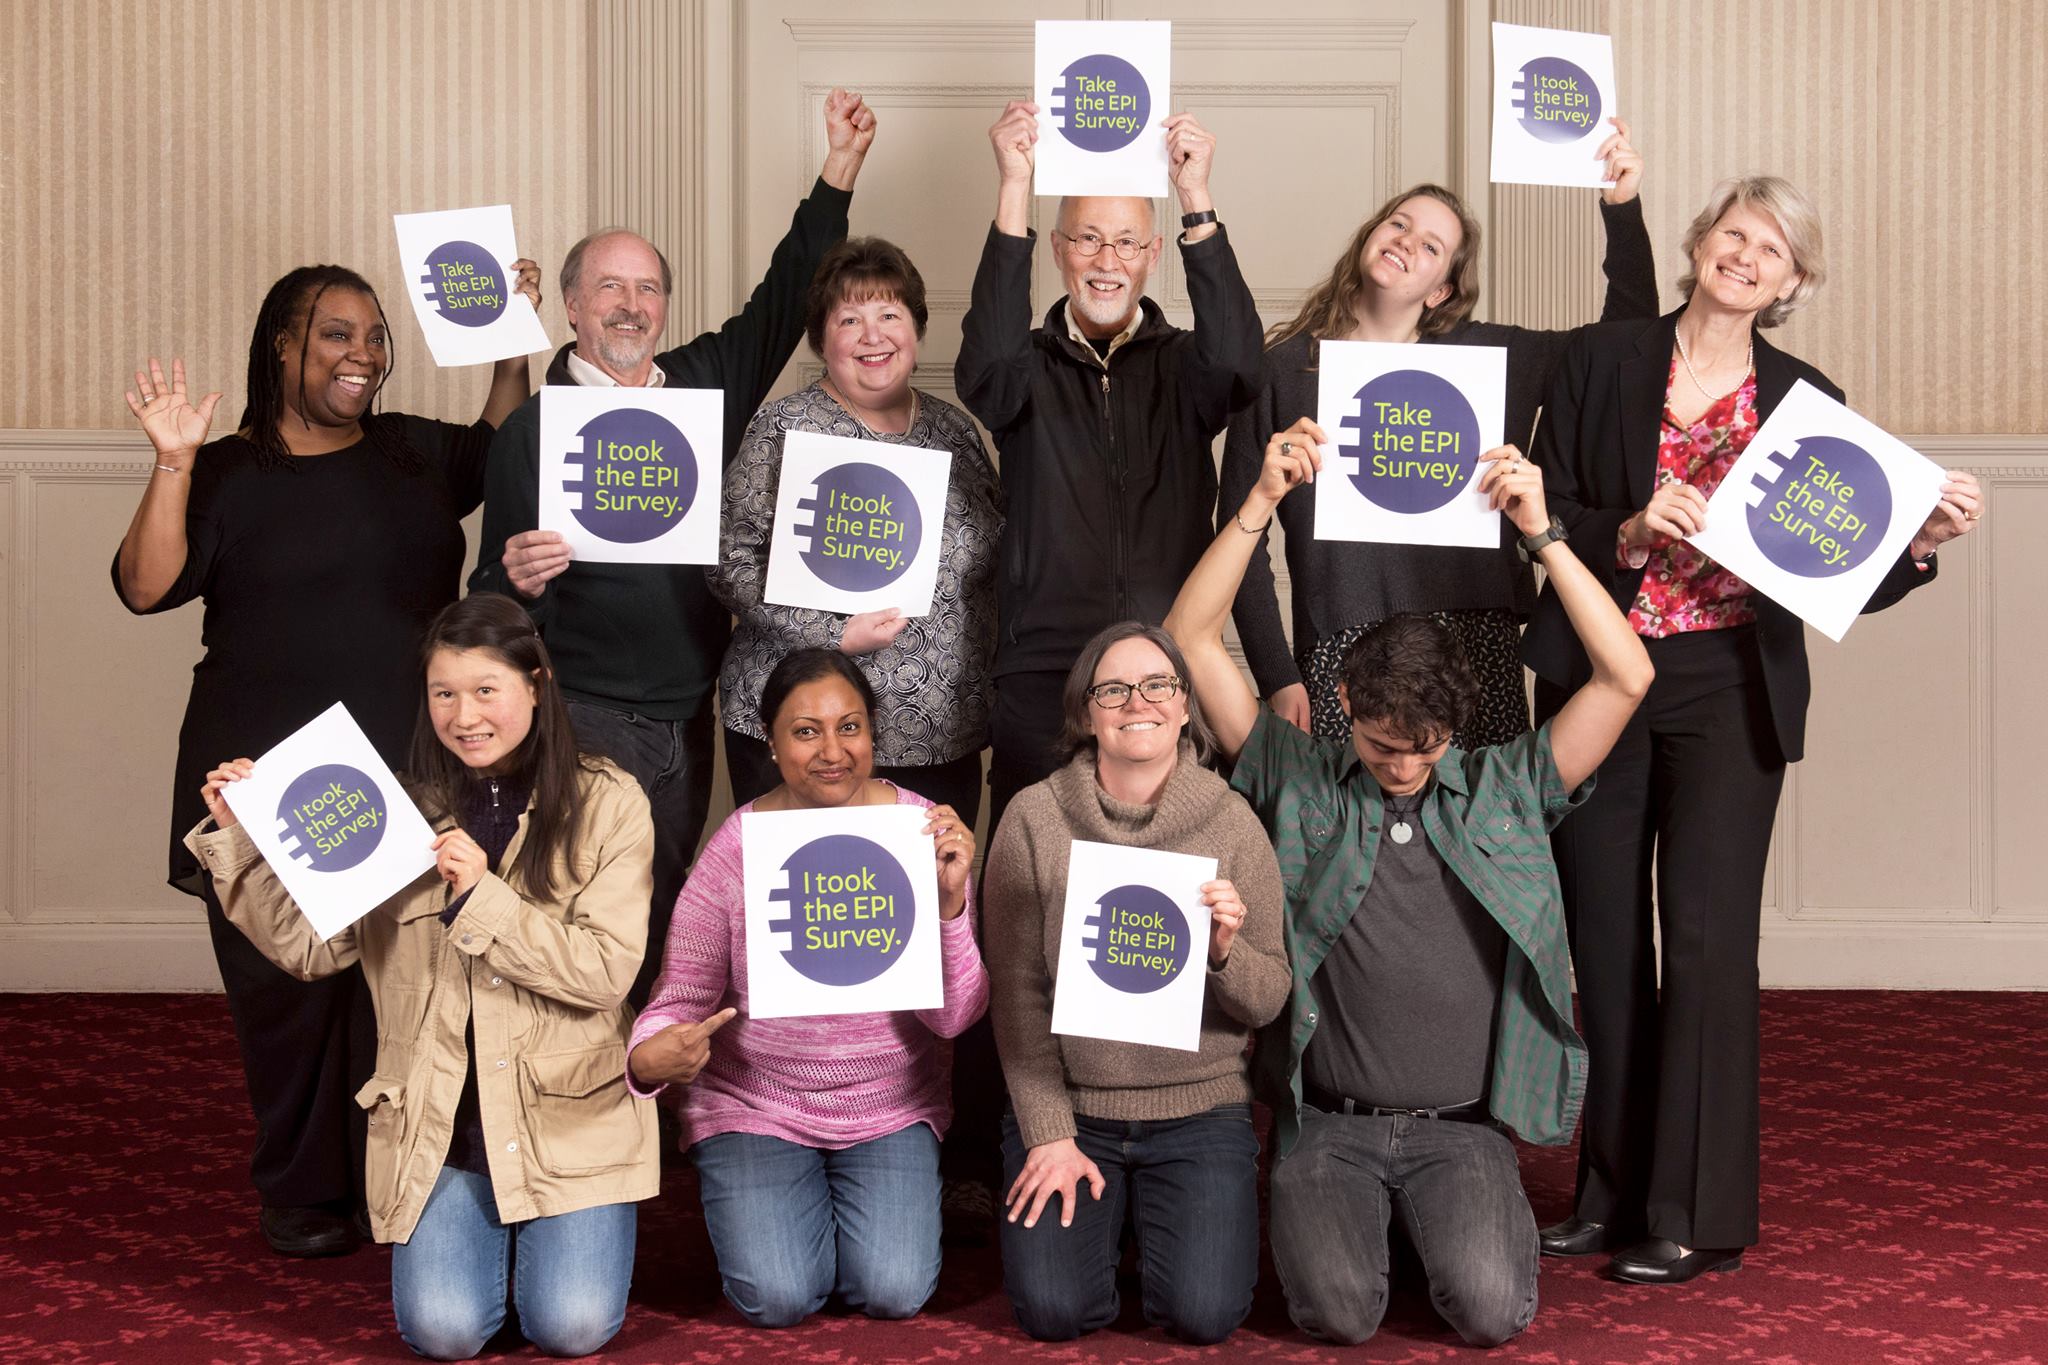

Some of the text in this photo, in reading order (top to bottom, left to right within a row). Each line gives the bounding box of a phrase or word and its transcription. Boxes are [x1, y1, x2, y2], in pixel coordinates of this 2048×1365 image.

[1076, 75, 1117, 92] Take
[1533, 74, 1577, 91] I took
[1075, 94, 1138, 111] the EPI
[1533, 90, 1588, 107] the EPI
[1075, 112, 1139, 133] Survey.
[1533, 106, 1593, 127] Survey.
[437, 261, 474, 278] Take
[441, 276, 495, 294] the EPI
[447, 294, 504, 309] Survey.
[1375, 402, 1432, 426] Take
[597, 440, 663, 462] I took
[1373, 428, 1459, 453] the EPI
[595, 464, 678, 488] the EPI
[1373, 454, 1464, 487] Survey.
[1804, 456, 1855, 502] Take
[595, 489, 683, 518] Survey.
[830, 489, 892, 516] I took
[1785, 480, 1867, 541] the EPI
[826, 512, 904, 541] the EPI
[1770, 501, 1849, 566] Survey.
[821, 536, 904, 571] Survey.
[294, 783, 346, 823] I took
[305, 788, 368, 838] the EPI
[316, 807, 383, 855] Survey.
[804, 866, 876, 895] I took
[803, 895, 895, 922] the EPI
[1111, 907, 1165, 930] I took
[806, 926, 901, 953] Survey.
[1109, 927, 1176, 952] the EPI
[1107, 946, 1176, 976] Survey.
